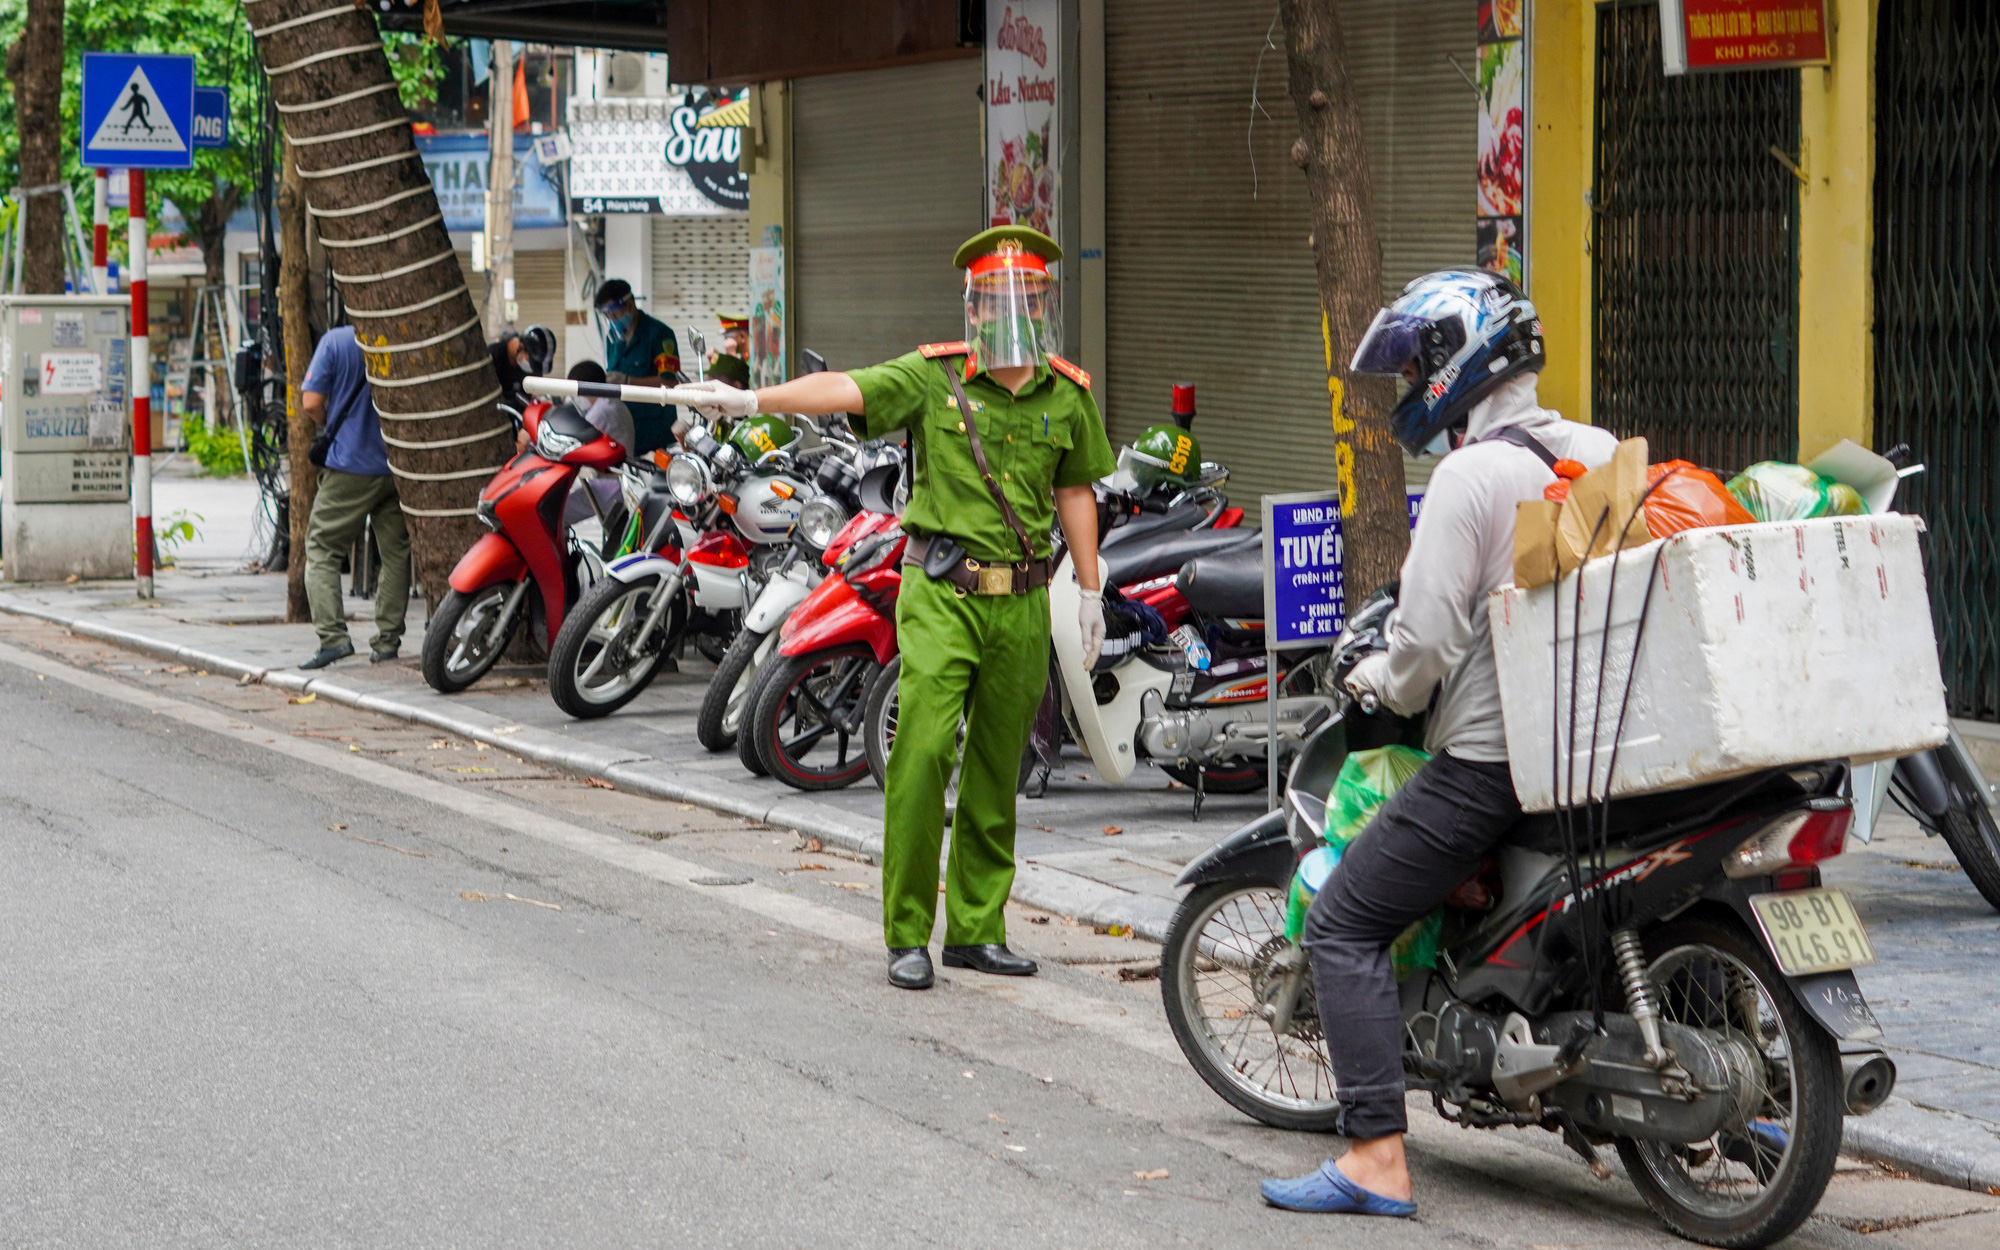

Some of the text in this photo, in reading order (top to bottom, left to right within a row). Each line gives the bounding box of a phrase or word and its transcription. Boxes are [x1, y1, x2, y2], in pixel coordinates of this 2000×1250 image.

[1715, 46, 1744, 60] KHU
[583, 197, 604, 214] 54
[1293, 507, 1323, 523] UBND
[1292, 570, 1320, 588] (TRÊN
[1308, 603, 1336, 618] KINH
[1317, 619, 1332, 633] XE
[1768, 893, 1845, 931] 98-B1
[1780, 927, 1868, 971] 146.91
